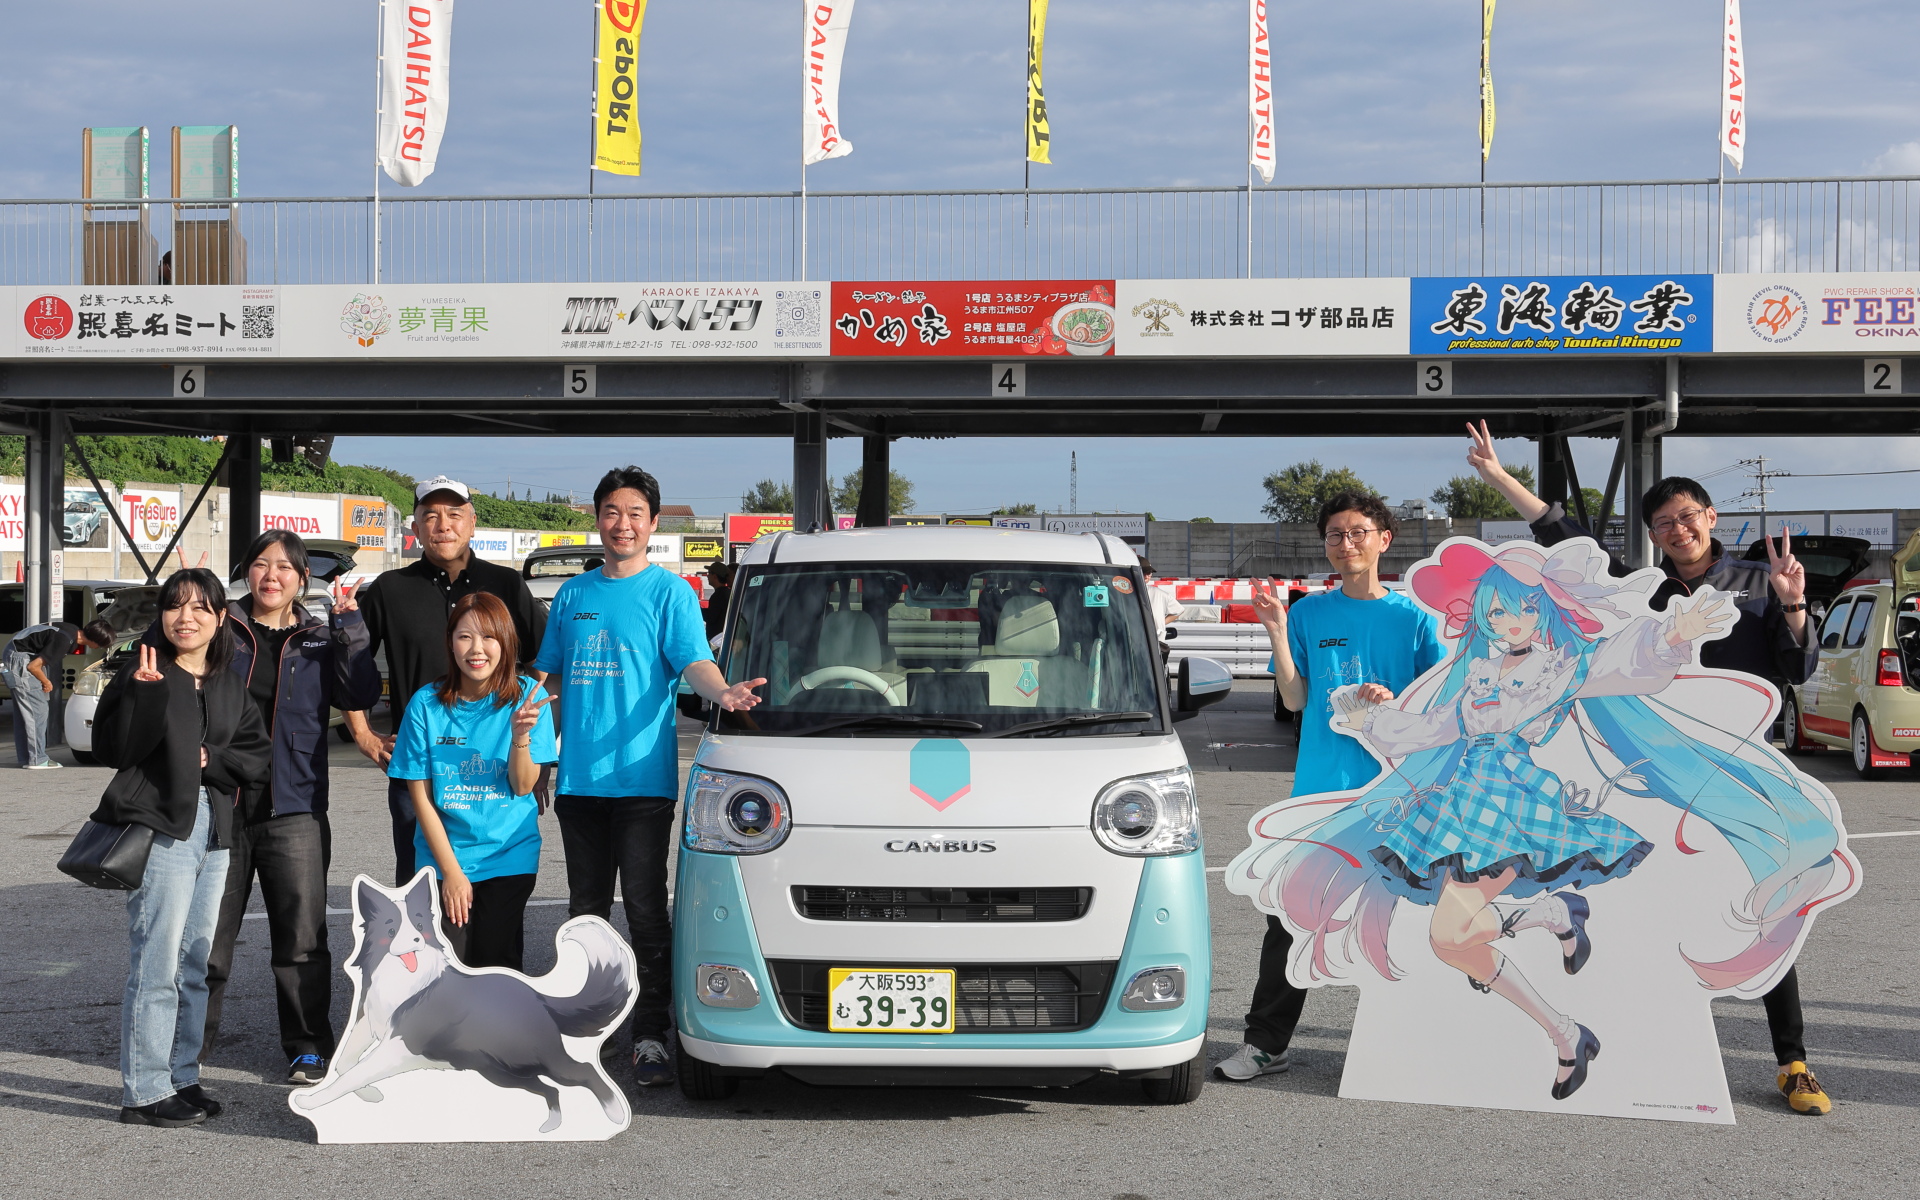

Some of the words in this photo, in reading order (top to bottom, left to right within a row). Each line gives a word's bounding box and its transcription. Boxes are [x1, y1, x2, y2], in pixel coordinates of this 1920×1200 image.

[401, 6, 432, 163] DAIHATSU
[811, 5, 839, 154] DAIHATSU
[643, 288, 699, 297] KARAOKE
[706, 287, 760, 296] IZAKAYA
[965, 293, 991, 303] 1号店
[996, 292, 1089, 303] うるまシティプラザ店
[1773, 284, 1803, 301] OKINAWA
[1824, 288, 1844, 296] PWC
[1846, 288, 1878, 296] REPAIR
[1879, 287, 1905, 296] SHOP
[1905, 287, 1915, 295] &
[963, 305, 1035, 315] うるま市江州507
[1430, 281, 1694, 336] 東海輪業
[1747, 301, 1755, 325] REPAIR
[1800, 300, 1809, 315] PWC
[1821, 296, 1920, 325] FEE
[398, 306, 490, 334] 夢青果
[561, 297, 620, 335] THE
[628, 299, 763, 332] ベストテン
[1190, 310, 1265, 327] 株式会社
[1271, 307, 1395, 329] コザ部品店
[77, 311, 237, 340] 照喜名ミート
[836, 303, 952, 347] かめ家
[963, 322, 993, 333] 2号店
[996, 322, 1027, 333] 塩屋店
[1793, 316, 1808, 338] REPAIR
[1750, 326, 1763, 338] SITE
[1855, 328, 1920, 338] OKINA
[441, 335, 480, 343] Vegetables
[561, 341, 663, 350] 沖縄県沖縄市上地2-21-15
[963, 335, 1042, 345] うるま市塩屋402-1
[1447, 338, 1511, 352] professional
[1511, 337, 1535, 349] auto
[1535, 336, 1560, 352] shop
[1563, 335, 1620, 349] Toukai
[1620, 334, 1683, 350] Ringyo
[1763, 335, 1773, 343] ON
[1774, 335, 1793, 344] SHOP
[180, 369, 197, 393] 6
[571, 369, 588, 393] 5
[998, 367, 1017, 392] 4
[1424, 365, 1443, 392] 3
[1873, 366, 1892, 393] 2
[123, 495, 177, 540] Treasure
[263, 514, 322, 534] HONDA
[1068, 521, 1097, 529] GRACE
[1777, 519, 1802, 532] Mrs
[468, 540, 485, 550] OYO
[485, 540, 508, 551] TIRES
[1729, 590, 1749, 598] BC
[572, 612, 600, 621] DBC
[302, 640, 328, 648] DBC
[1318, 638, 1349, 649] DBC
[572, 660, 619, 669] CANBUS
[571, 669, 605, 677] HATSUNE
[605, 669, 625, 678] MIKU
[570, 678, 593, 686] Edition
[436, 736, 468, 746] DBC
[444, 784, 497, 792] CANBUS
[443, 793, 483, 801] HATSUNE
[484, 791, 507, 801] MIKU
[443, 801, 471, 810] Edition
[884, 840, 997, 853] CANBUS
[859, 974, 927, 991] 大阪593
[836, 1002, 851, 1019] む
[856, 995, 948, 1028] 39-39
